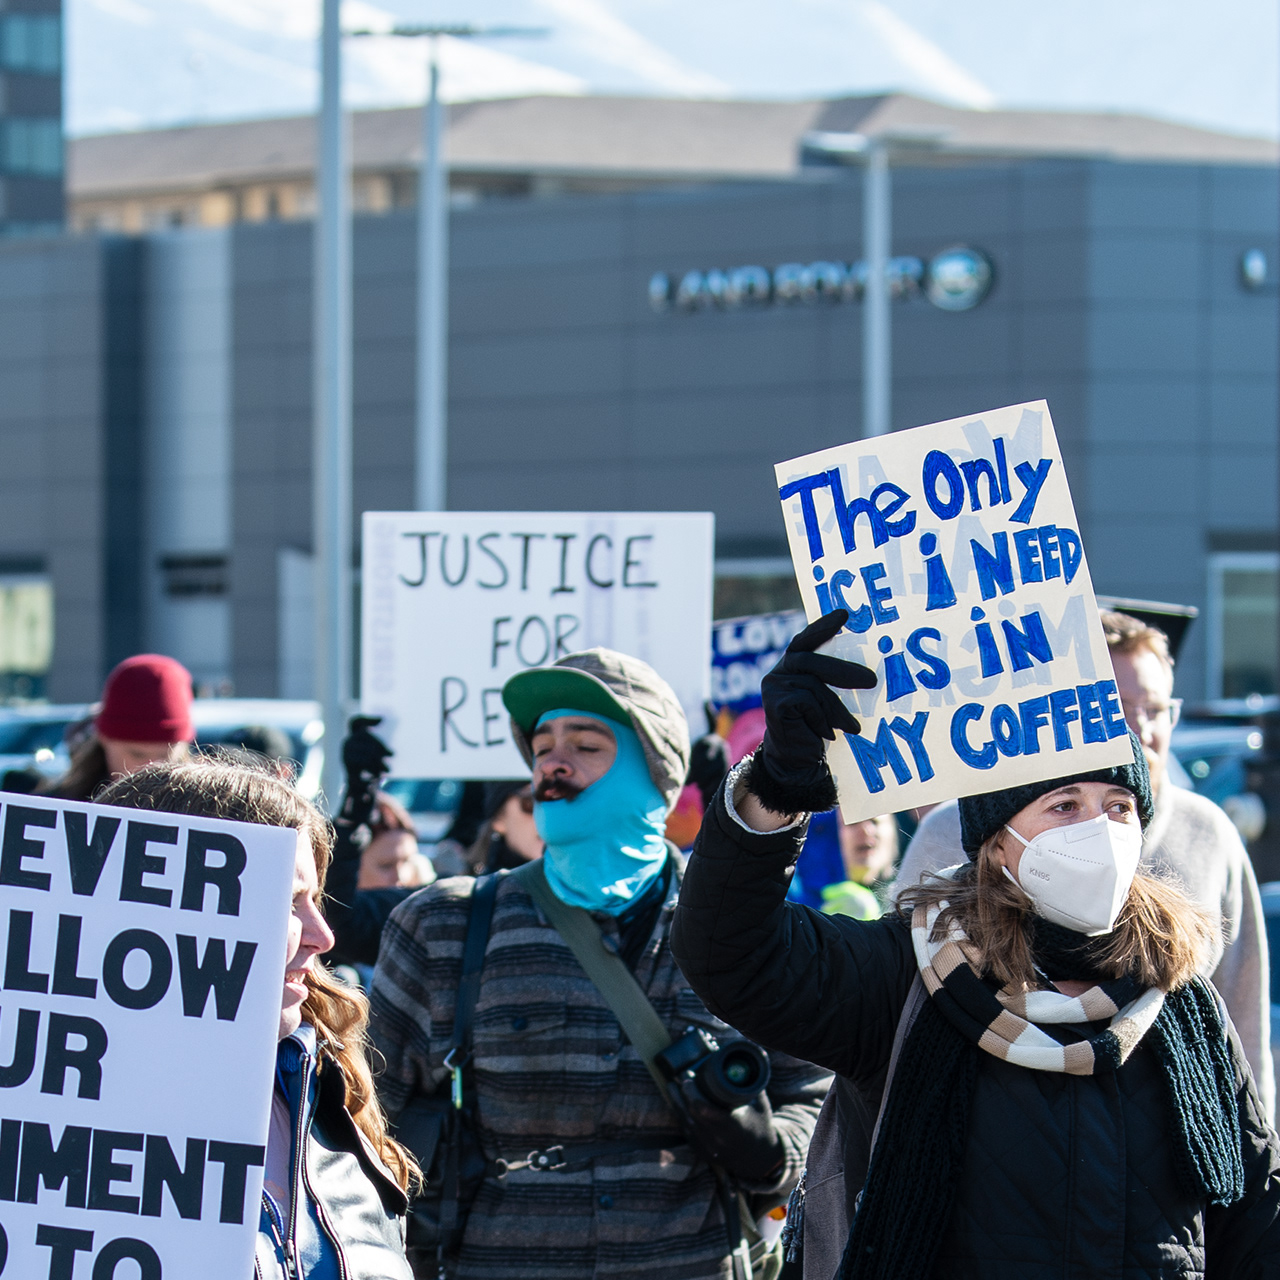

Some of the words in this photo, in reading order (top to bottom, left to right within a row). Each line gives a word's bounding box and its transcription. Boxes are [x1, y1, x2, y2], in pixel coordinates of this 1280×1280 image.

[778, 467, 918, 564] The
[922, 436, 1054, 526] Only
[399, 531, 659, 598] JUSTICE
[970, 523, 1083, 603] NEED
[490, 614, 581, 669] FOR
[843, 711, 931, 795] MY
[950, 679, 1129, 771] COFFEE
[1028, 867, 1051, 882] KN95
